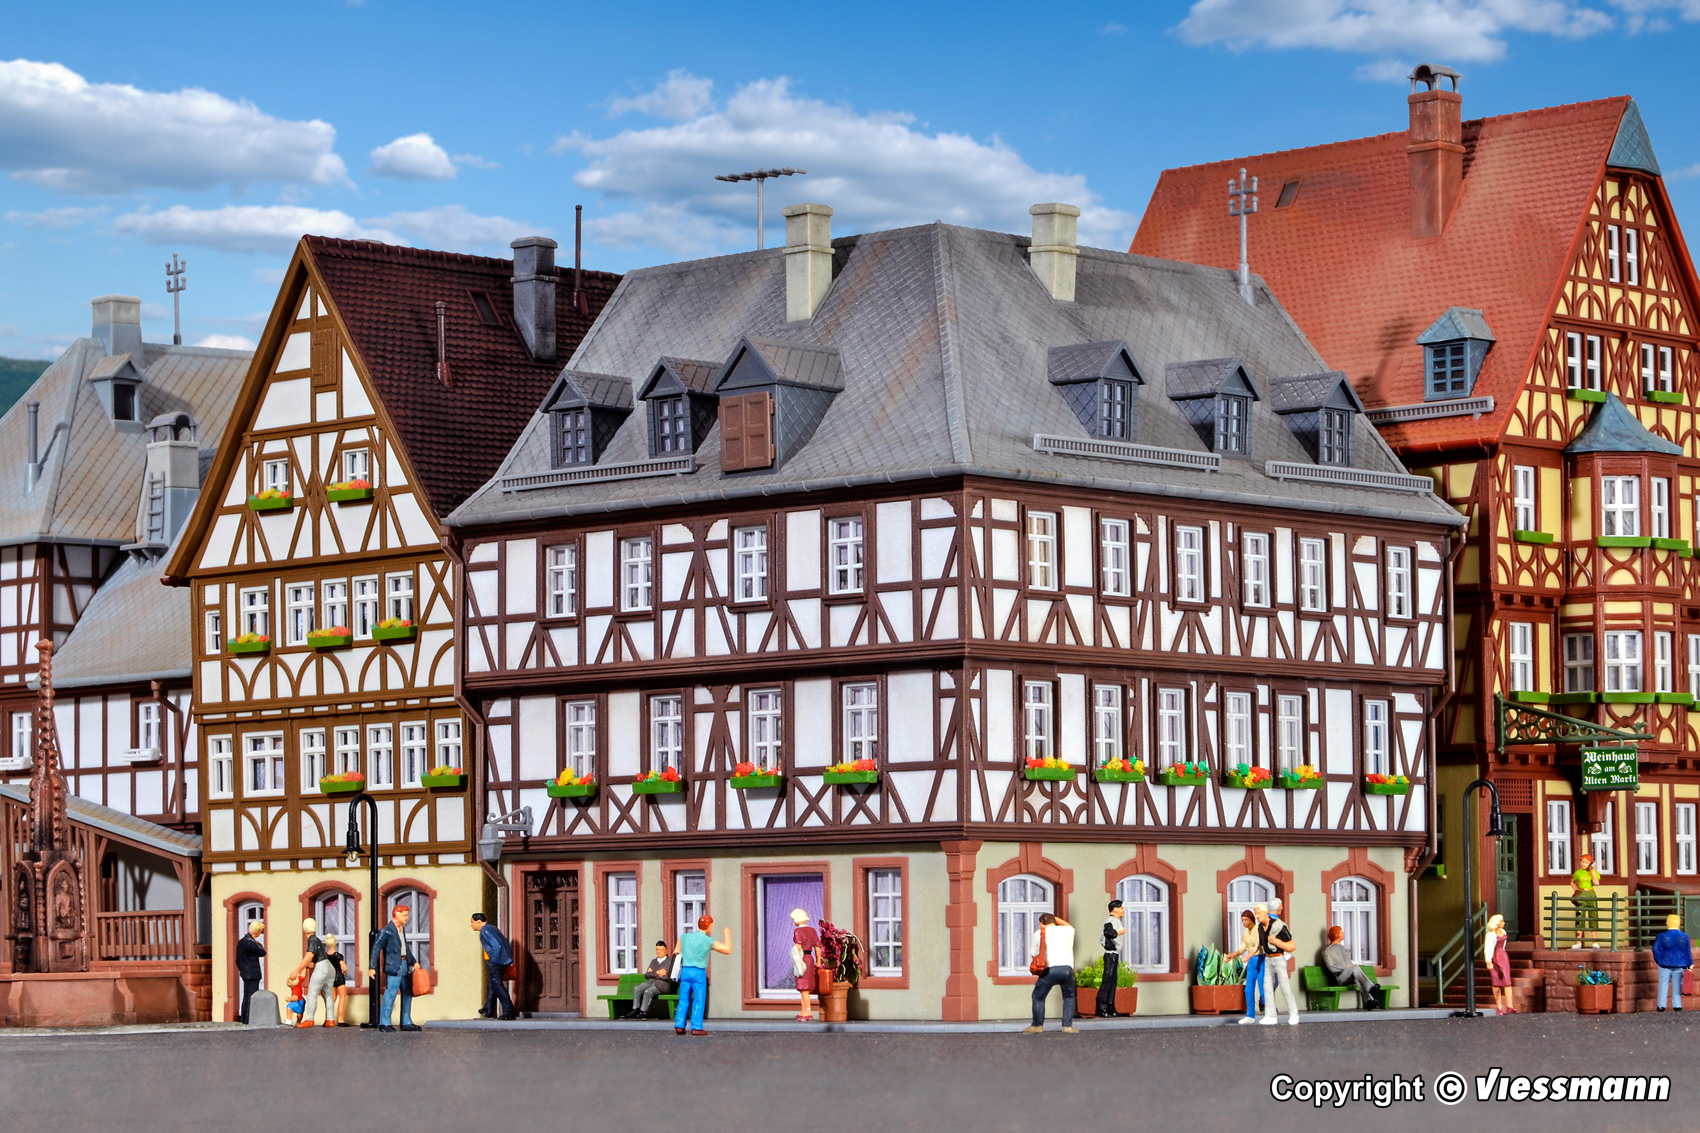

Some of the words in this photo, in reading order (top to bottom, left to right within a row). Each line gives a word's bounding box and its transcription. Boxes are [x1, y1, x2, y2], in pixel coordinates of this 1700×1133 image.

[1583, 751, 1635, 764] Weinhaus
[1584, 776, 1607, 785] Alten
[1610, 775, 1636, 783] Markt
